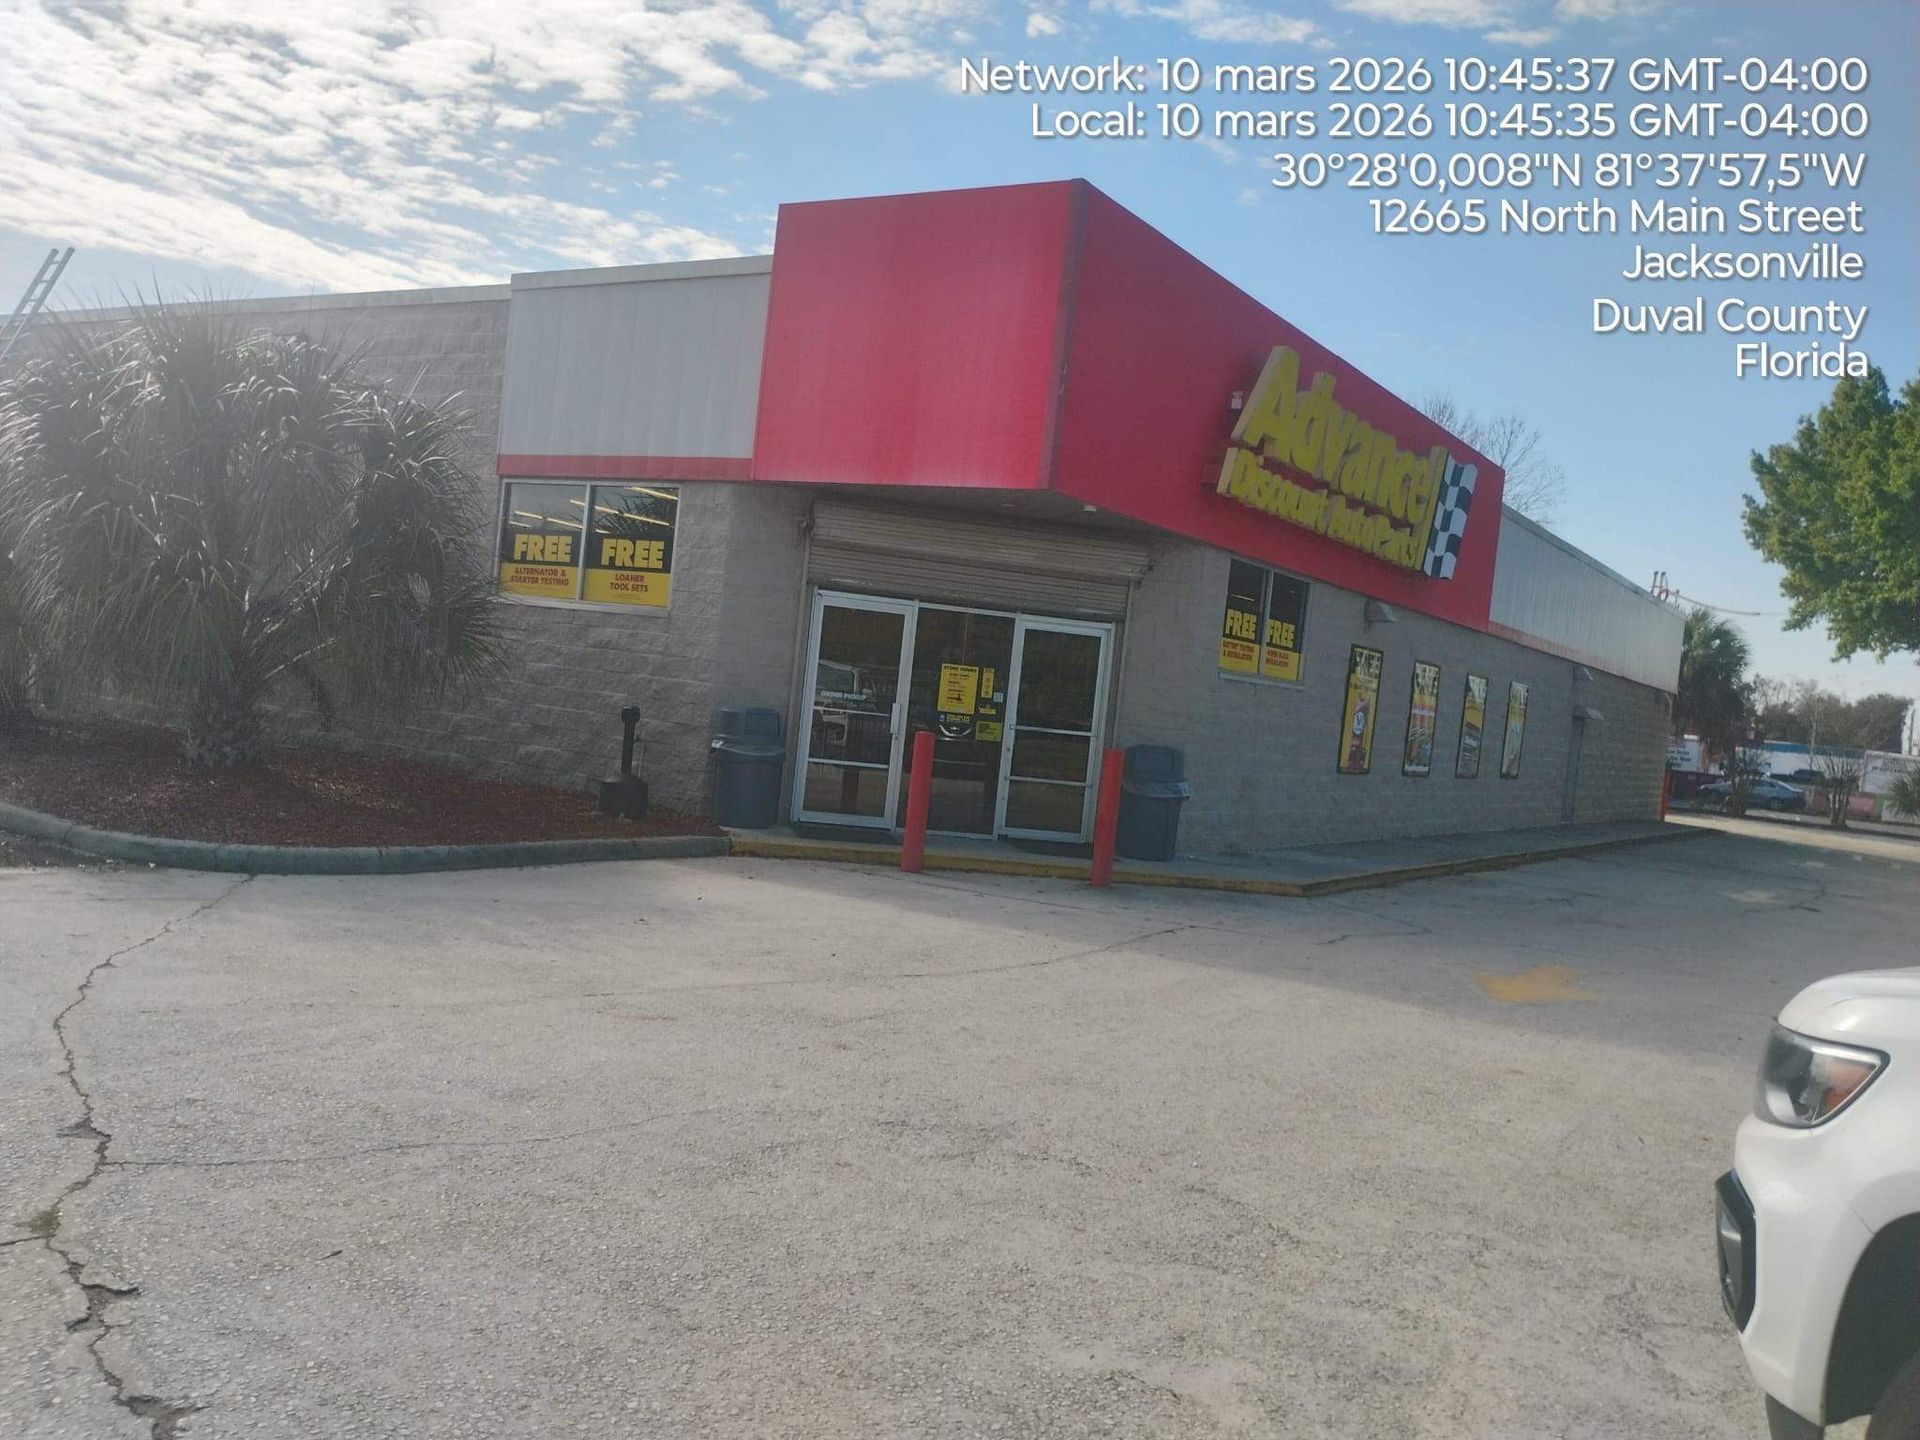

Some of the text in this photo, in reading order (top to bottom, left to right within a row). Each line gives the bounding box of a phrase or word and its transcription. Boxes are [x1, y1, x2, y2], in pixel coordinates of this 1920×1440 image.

[513, 533, 573, 564] FREE
[601, 538, 666, 569] FREE
[514, 567, 559, 577] ALTERNATOR
[541, 577, 570, 586] TESTING
[610, 581, 649, 593] TOOL SETS
[1225, 608, 1258, 640] FREE
[1267, 619, 1296, 647] FREE
